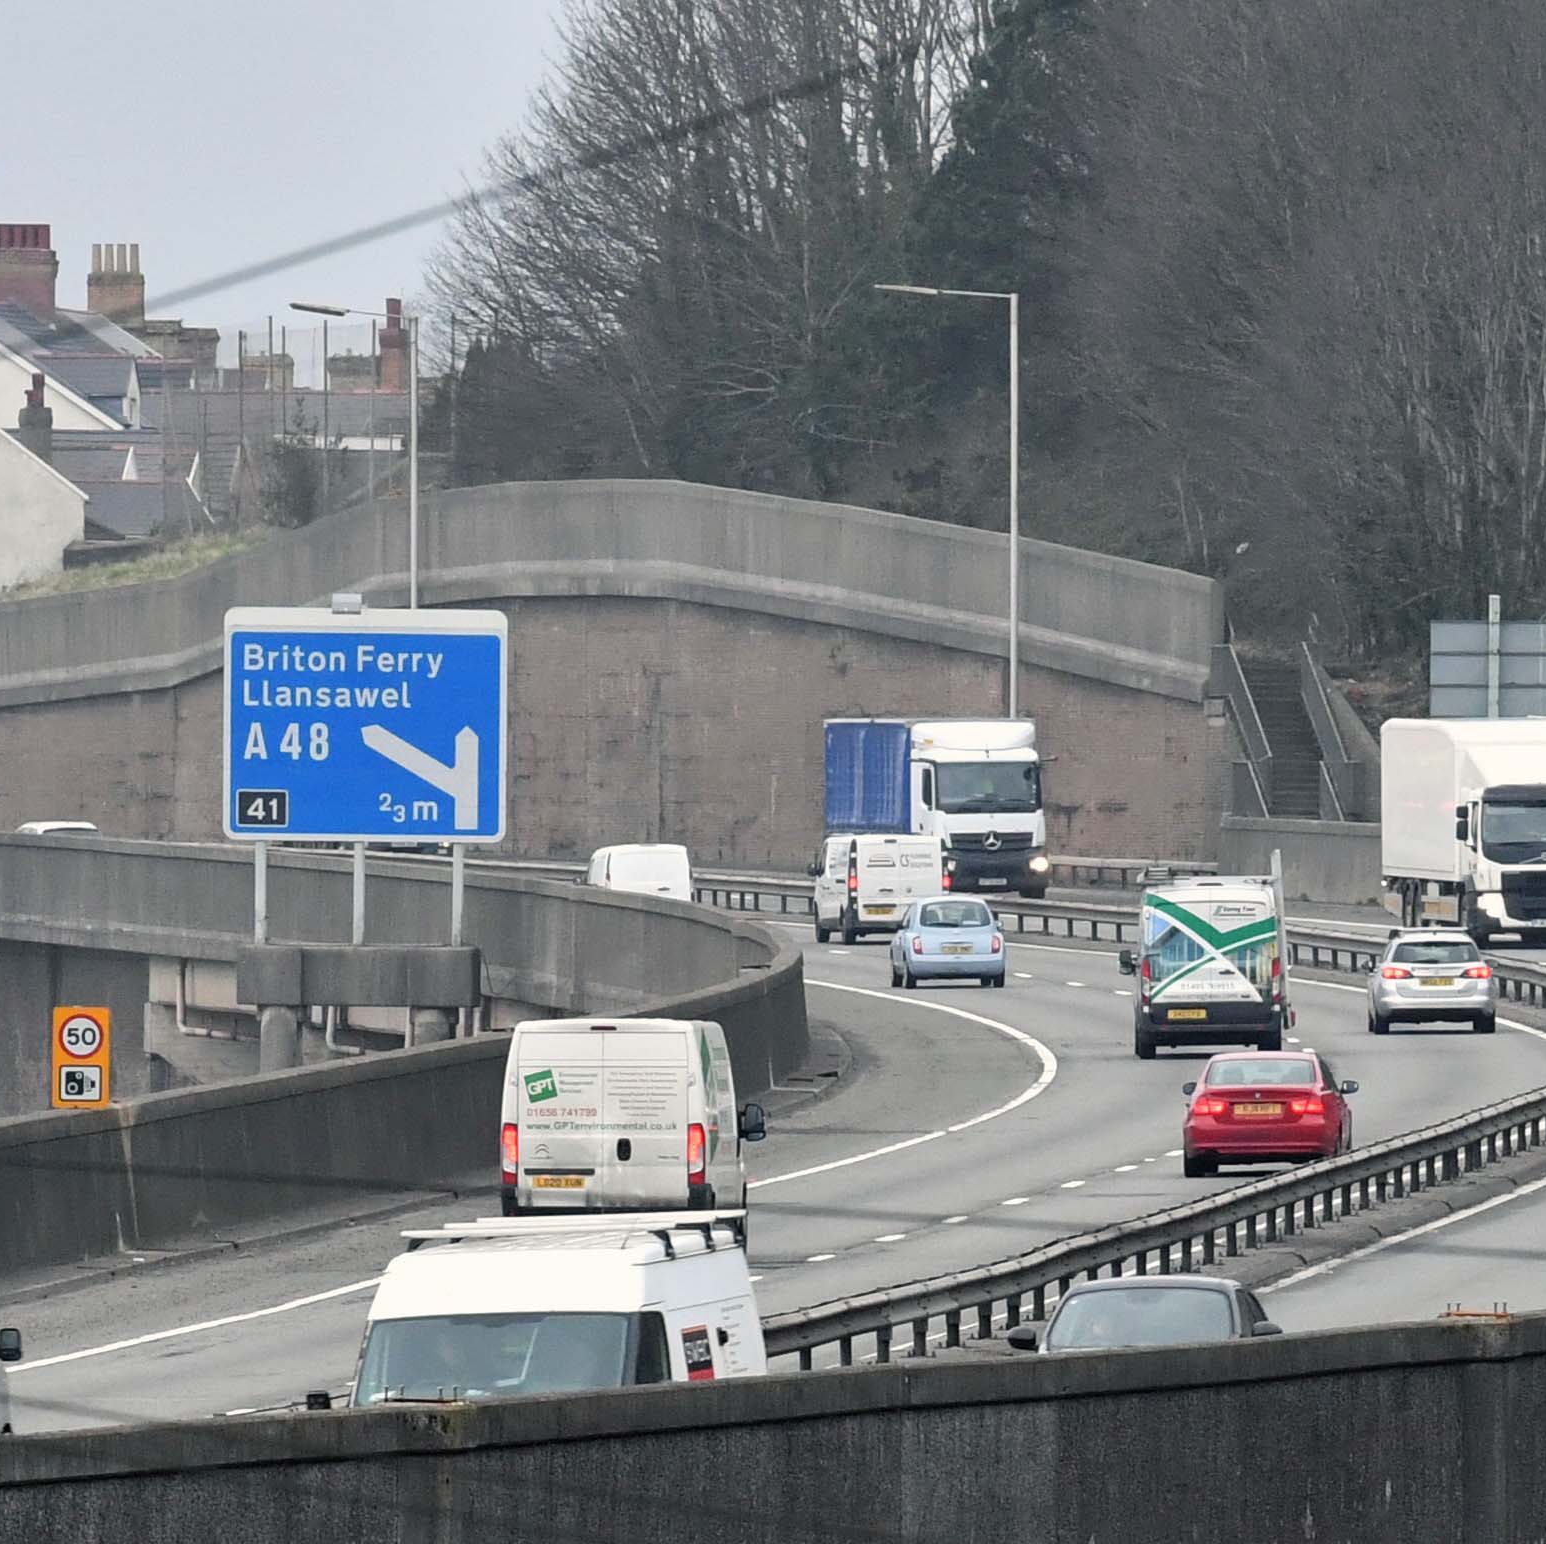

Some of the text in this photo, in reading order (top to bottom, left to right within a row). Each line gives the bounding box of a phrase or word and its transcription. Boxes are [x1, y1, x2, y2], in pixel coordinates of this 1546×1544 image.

[243, 644, 444, 677] Briton Ferry
[243, 680, 411, 708] Llansawel
[246, 798, 278, 820] 41
[66, 1028, 96, 1046] 50
[528, 1079, 554, 1095] GPT
